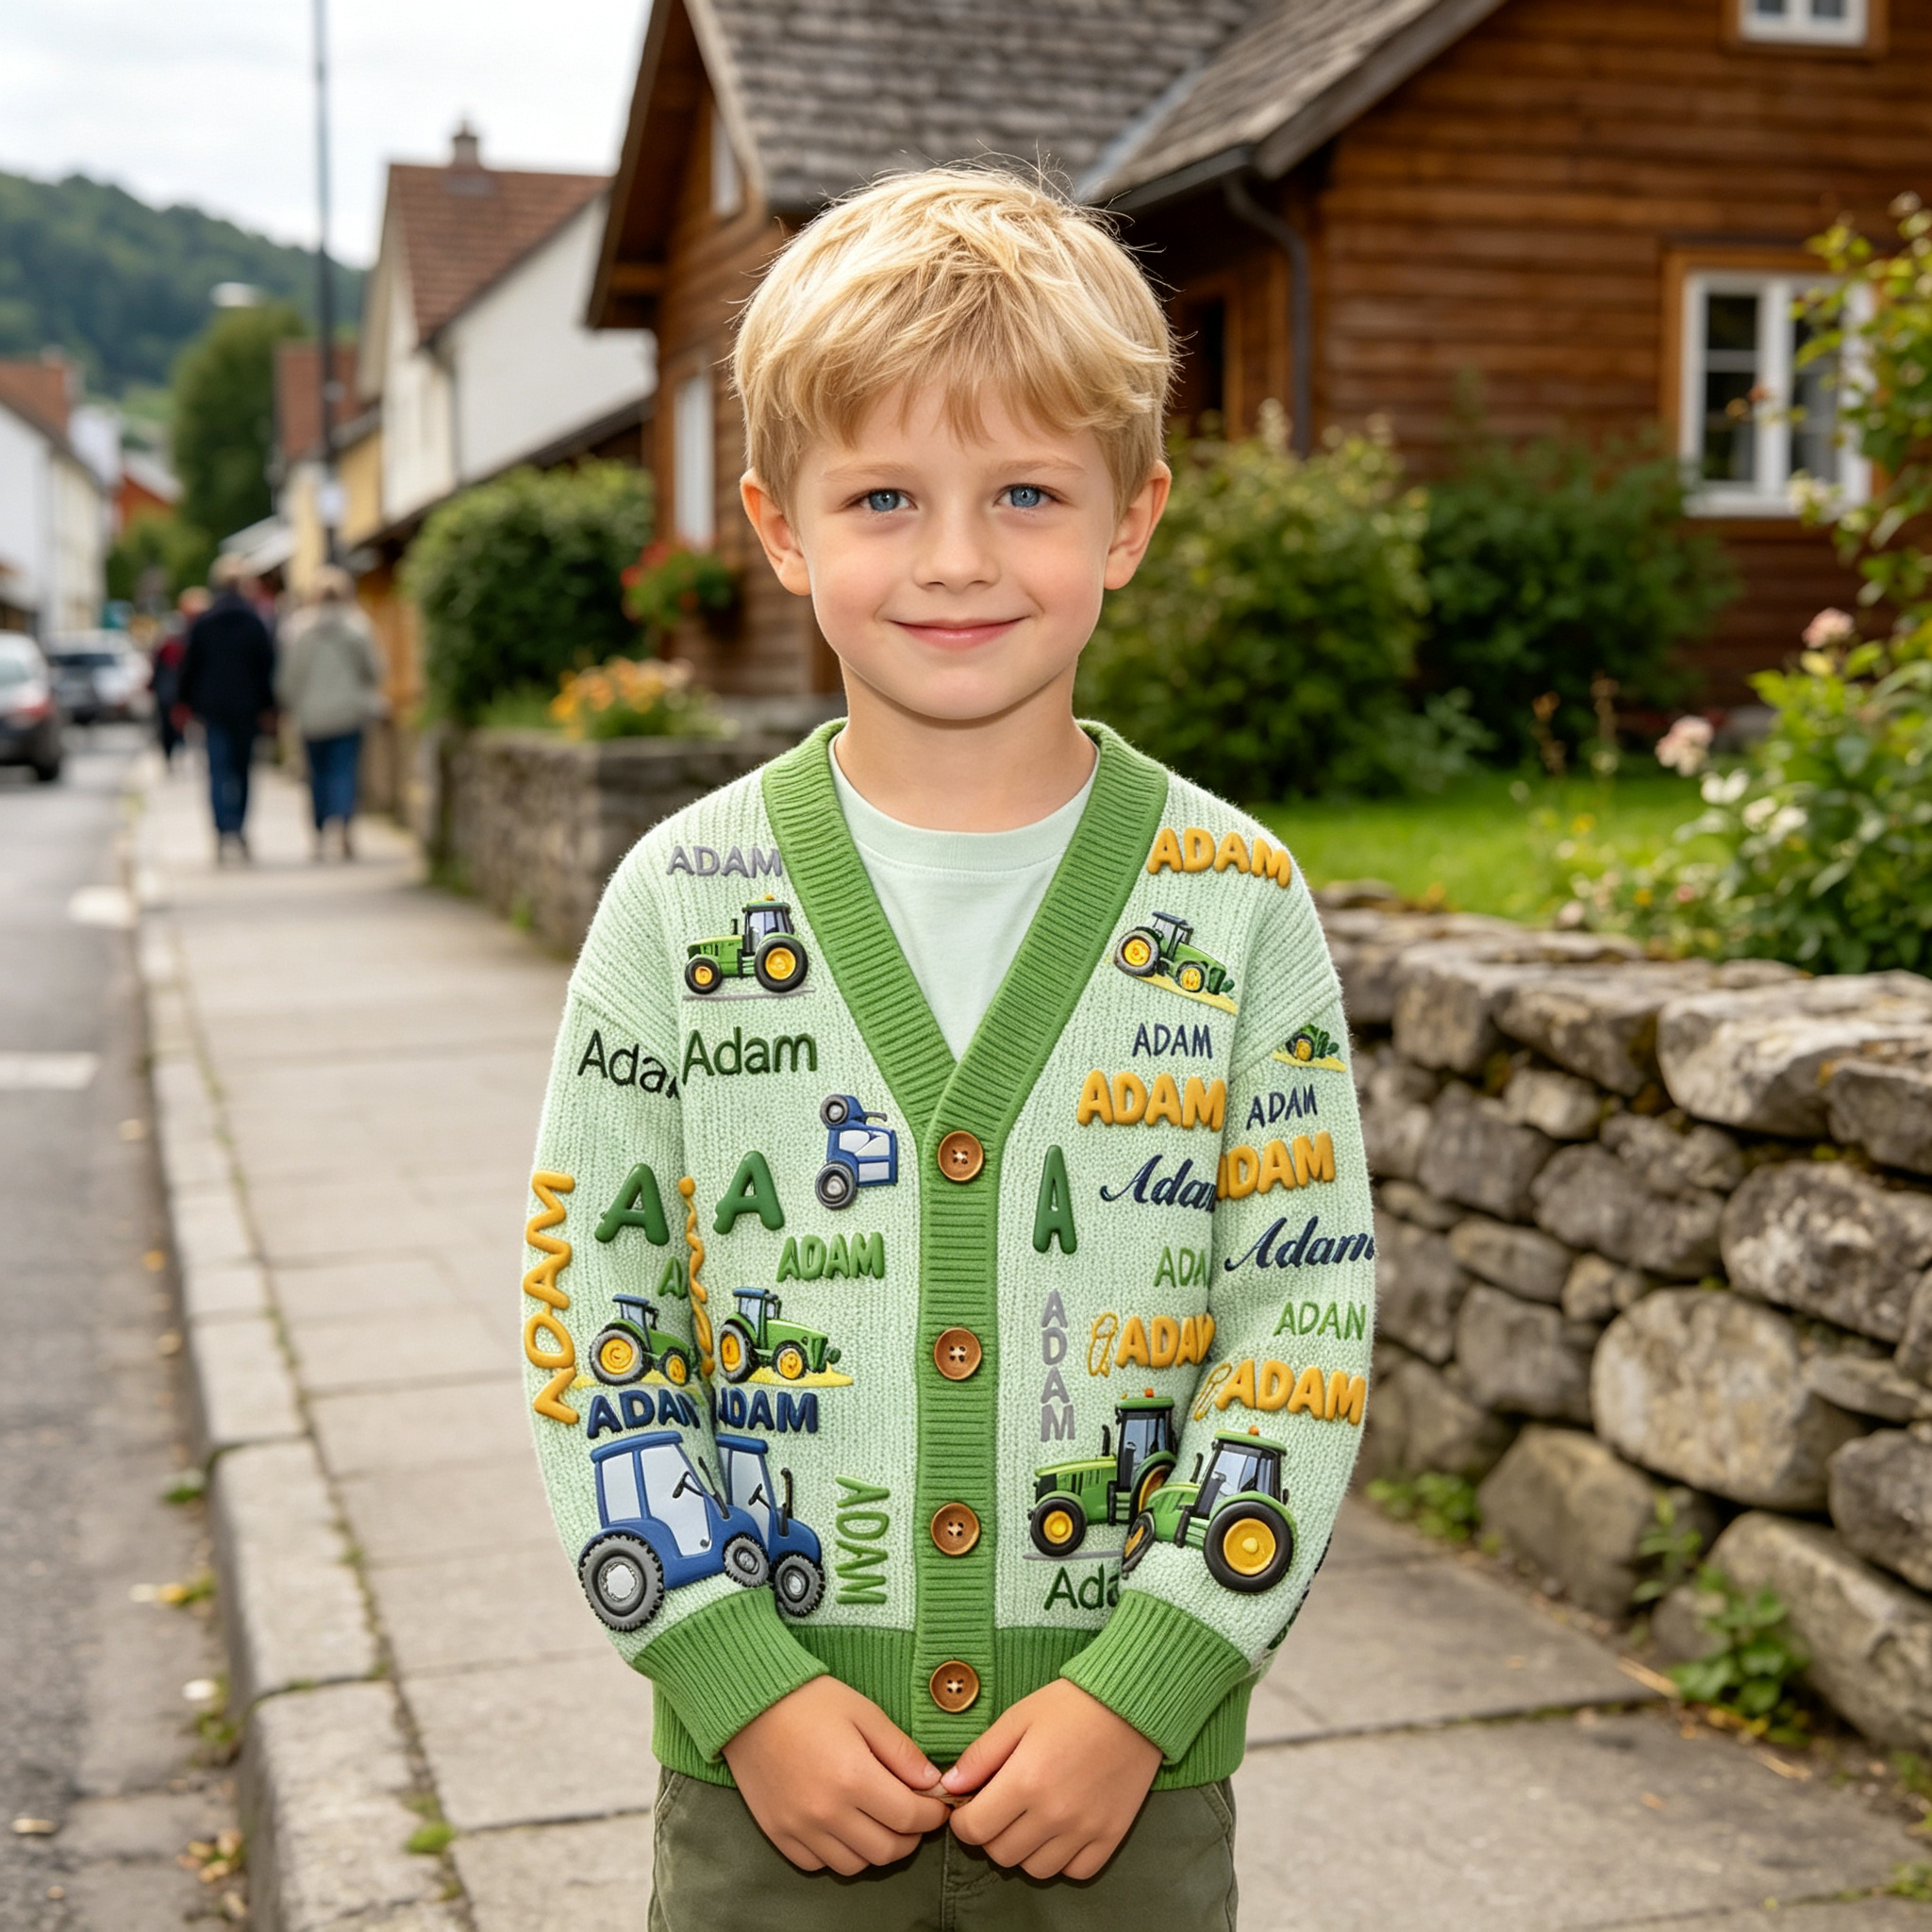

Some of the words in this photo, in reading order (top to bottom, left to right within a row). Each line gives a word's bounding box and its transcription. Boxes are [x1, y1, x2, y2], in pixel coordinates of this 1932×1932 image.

[666, 845, 782, 878] ADAM
[1146, 827, 1291, 889] ADAM
[682, 1026, 818, 1085] Adam
[1132, 1023, 1212, 1058] ADAM
[1076, 1069, 1226, 1131] ADAM
[1246, 1084, 1318, 1130] ADAM
[594, 1163, 670, 1246] A
[712, 1150, 785, 1235] A
[1032, 1144, 1077, 1255] A
[775, 1231, 886, 1283] ADAM
[1214, 1357, 1367, 1426] ADAM
[835, 1474, 891, 1605] ADAM
